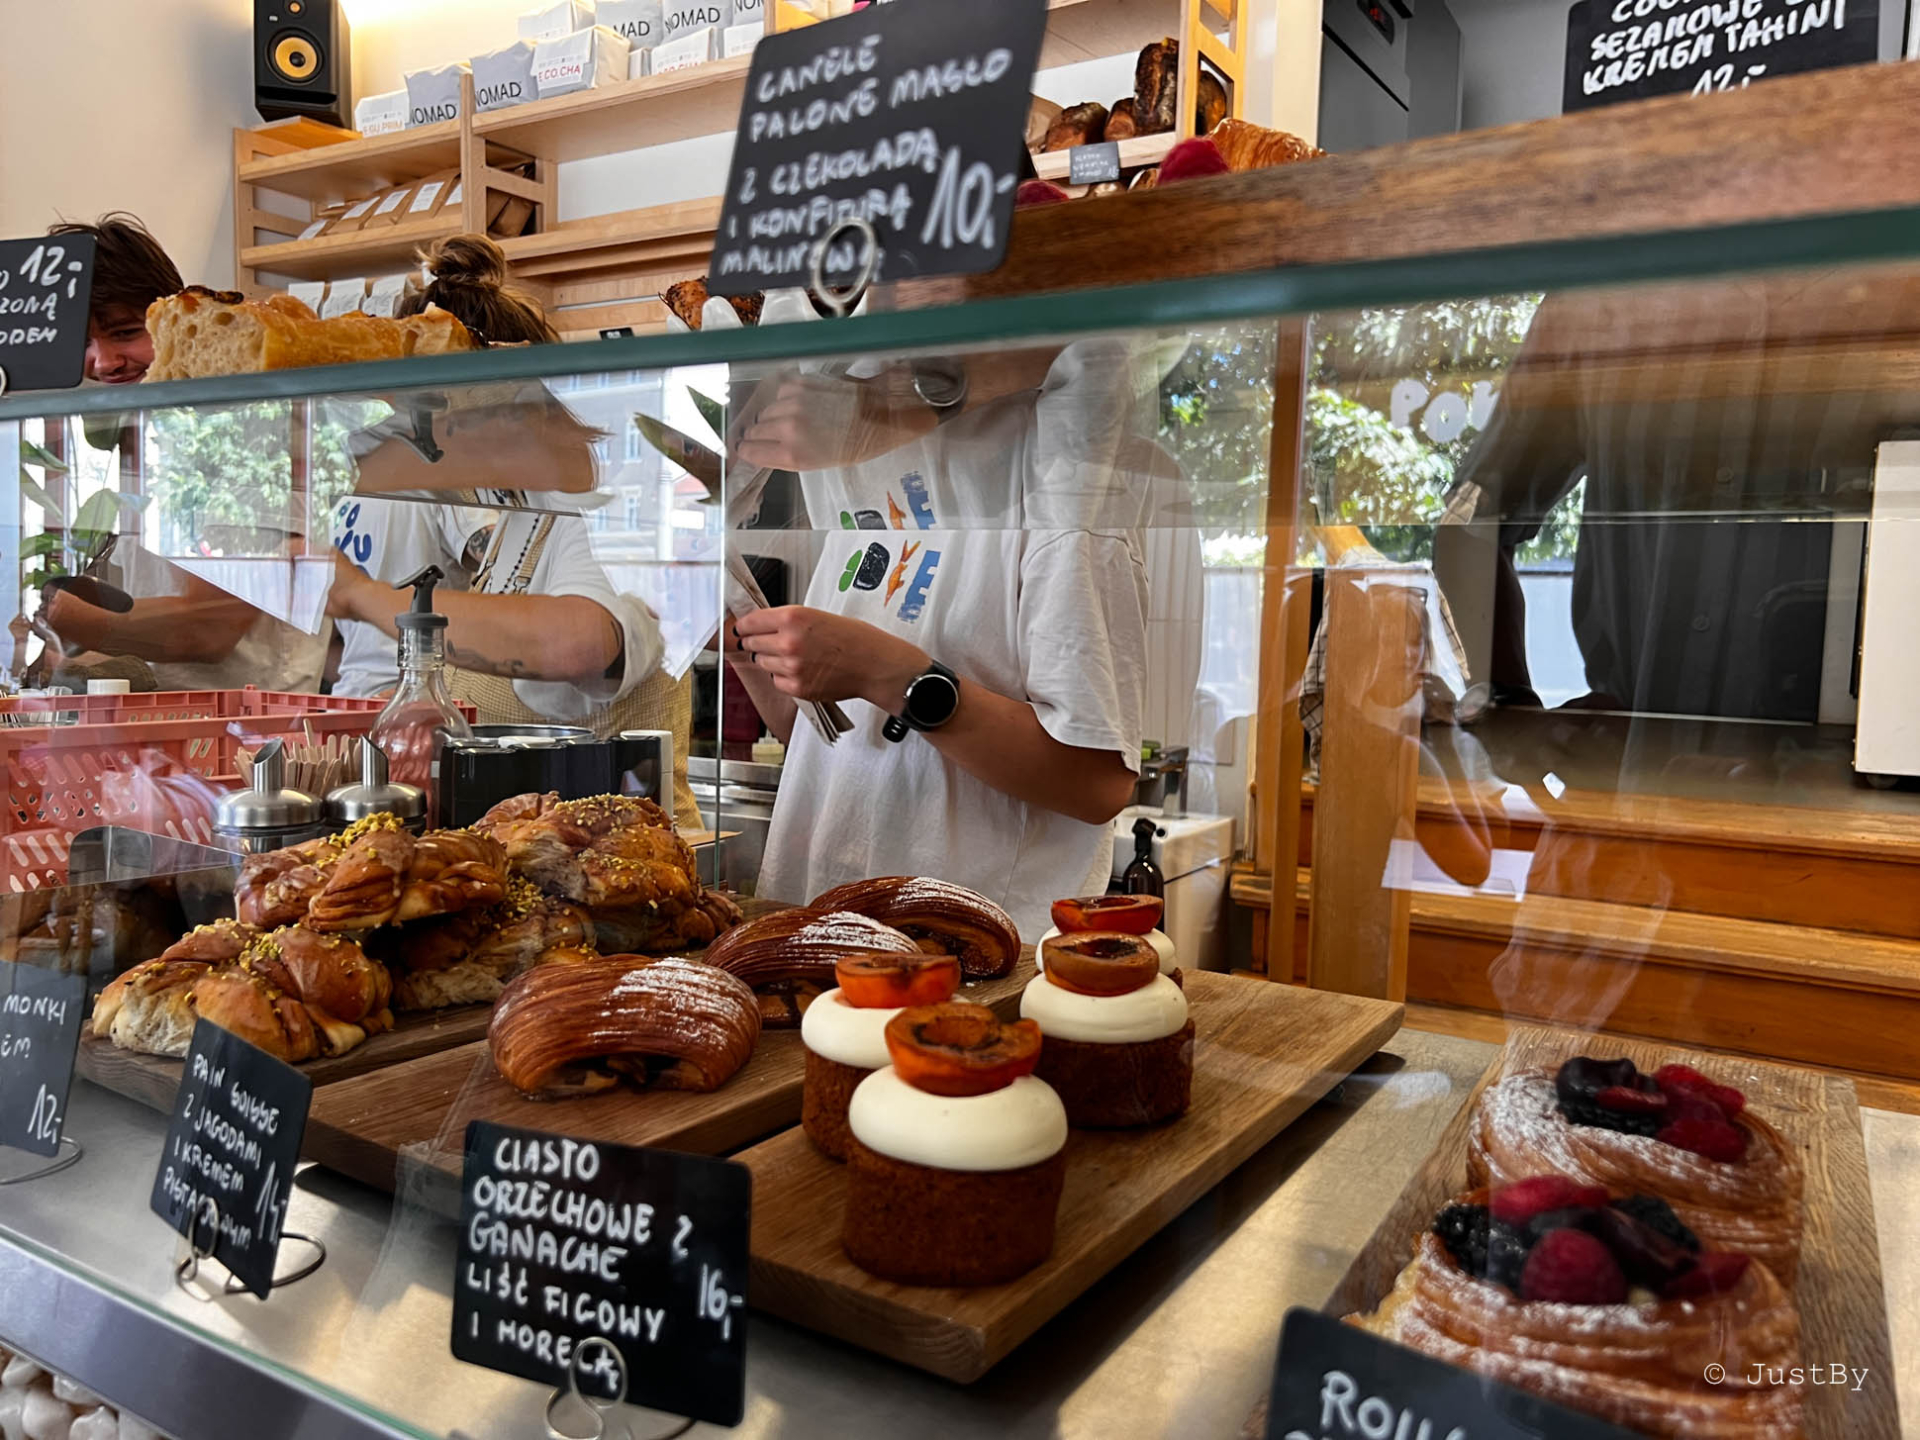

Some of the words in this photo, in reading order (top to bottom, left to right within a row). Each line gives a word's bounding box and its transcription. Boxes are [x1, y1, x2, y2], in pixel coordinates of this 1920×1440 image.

[664, 7, 721, 34] NOMAD
[193, 1053, 226, 1088] PAIN
[194, 1105, 262, 1171] JAGODAMI
[494, 1137, 600, 1180] CIASTO
[182, 1141, 244, 1192] KREMEM
[473, 1175, 654, 1244] ORZECHOWE
[469, 1211, 628, 1281] GANACHE
[544, 1285, 665, 1343] FIGOWY
